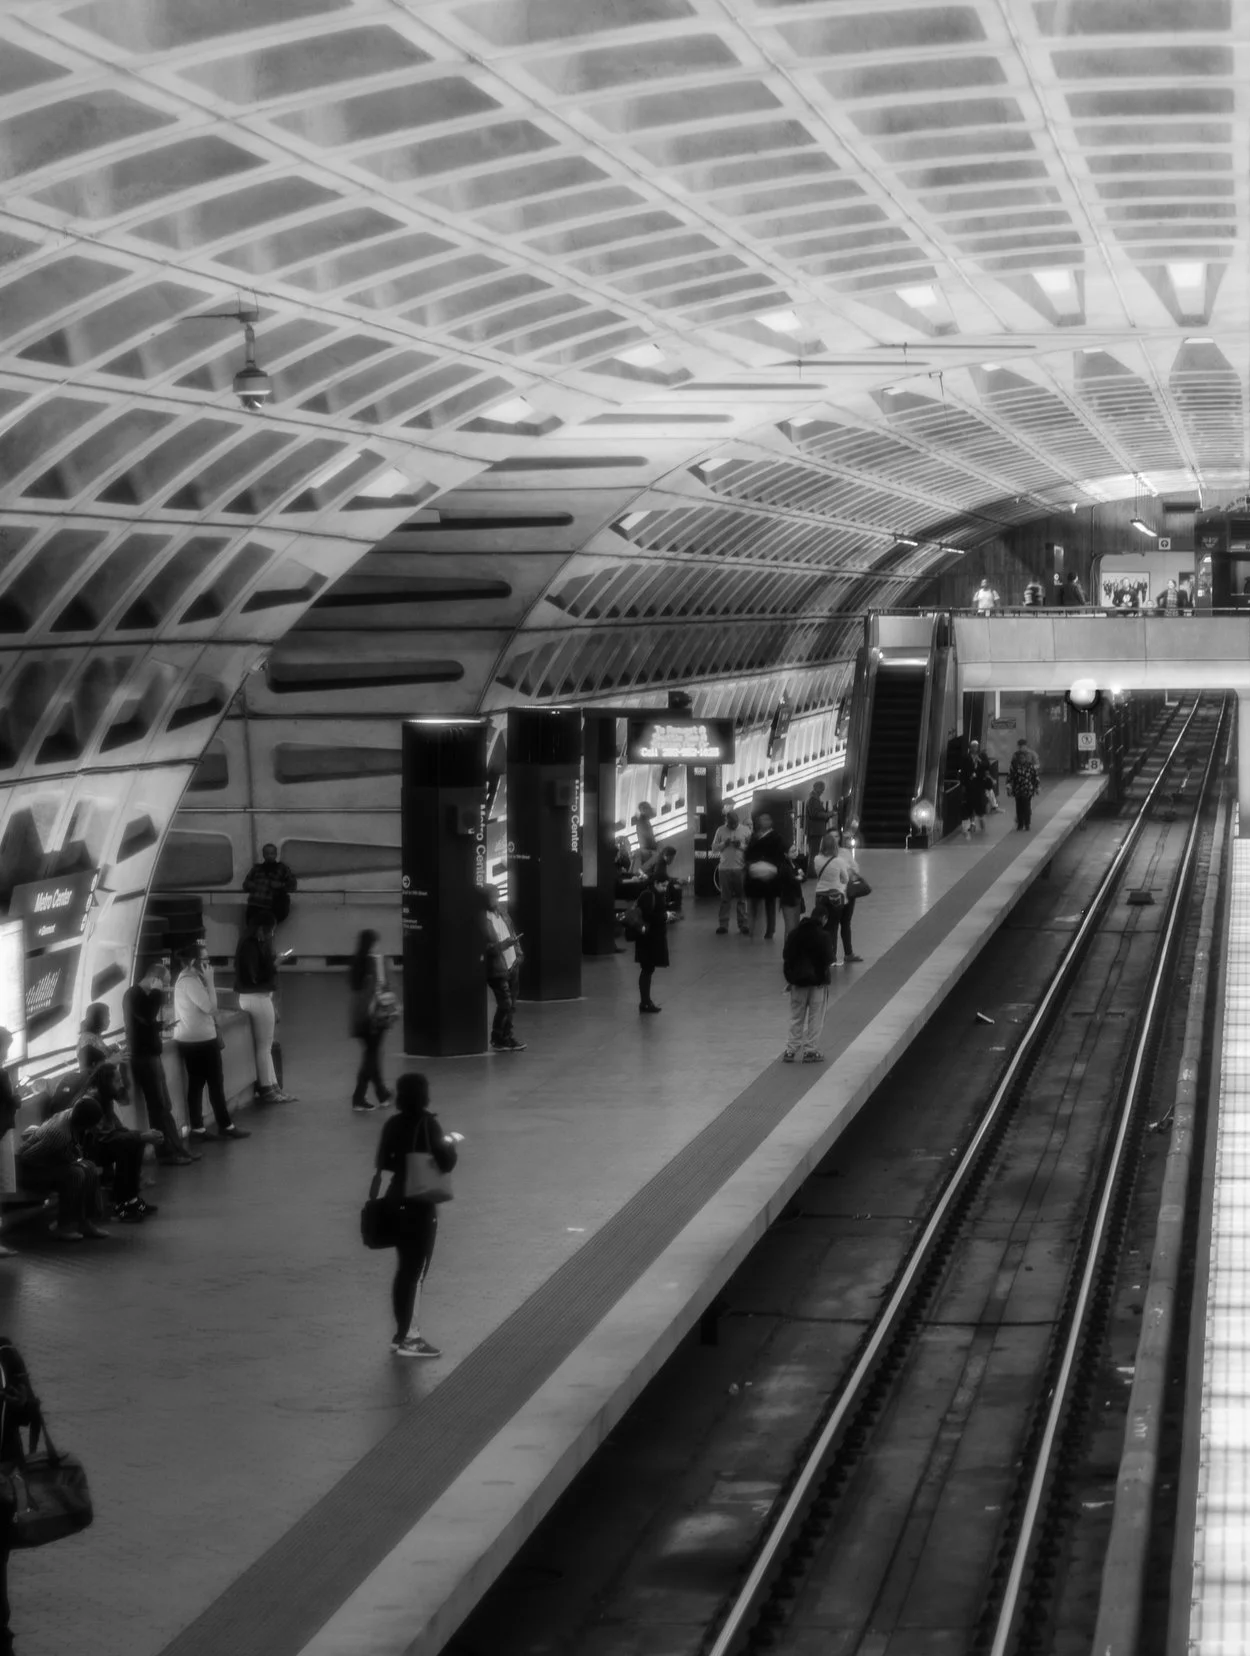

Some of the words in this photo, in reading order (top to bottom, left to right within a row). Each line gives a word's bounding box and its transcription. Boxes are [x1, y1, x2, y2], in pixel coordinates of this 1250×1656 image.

[641, 747, 658, 757] Call
[571, 815, 580, 853] Center
[476, 844, 486, 888] Center
[52, 888, 72, 909] Center
